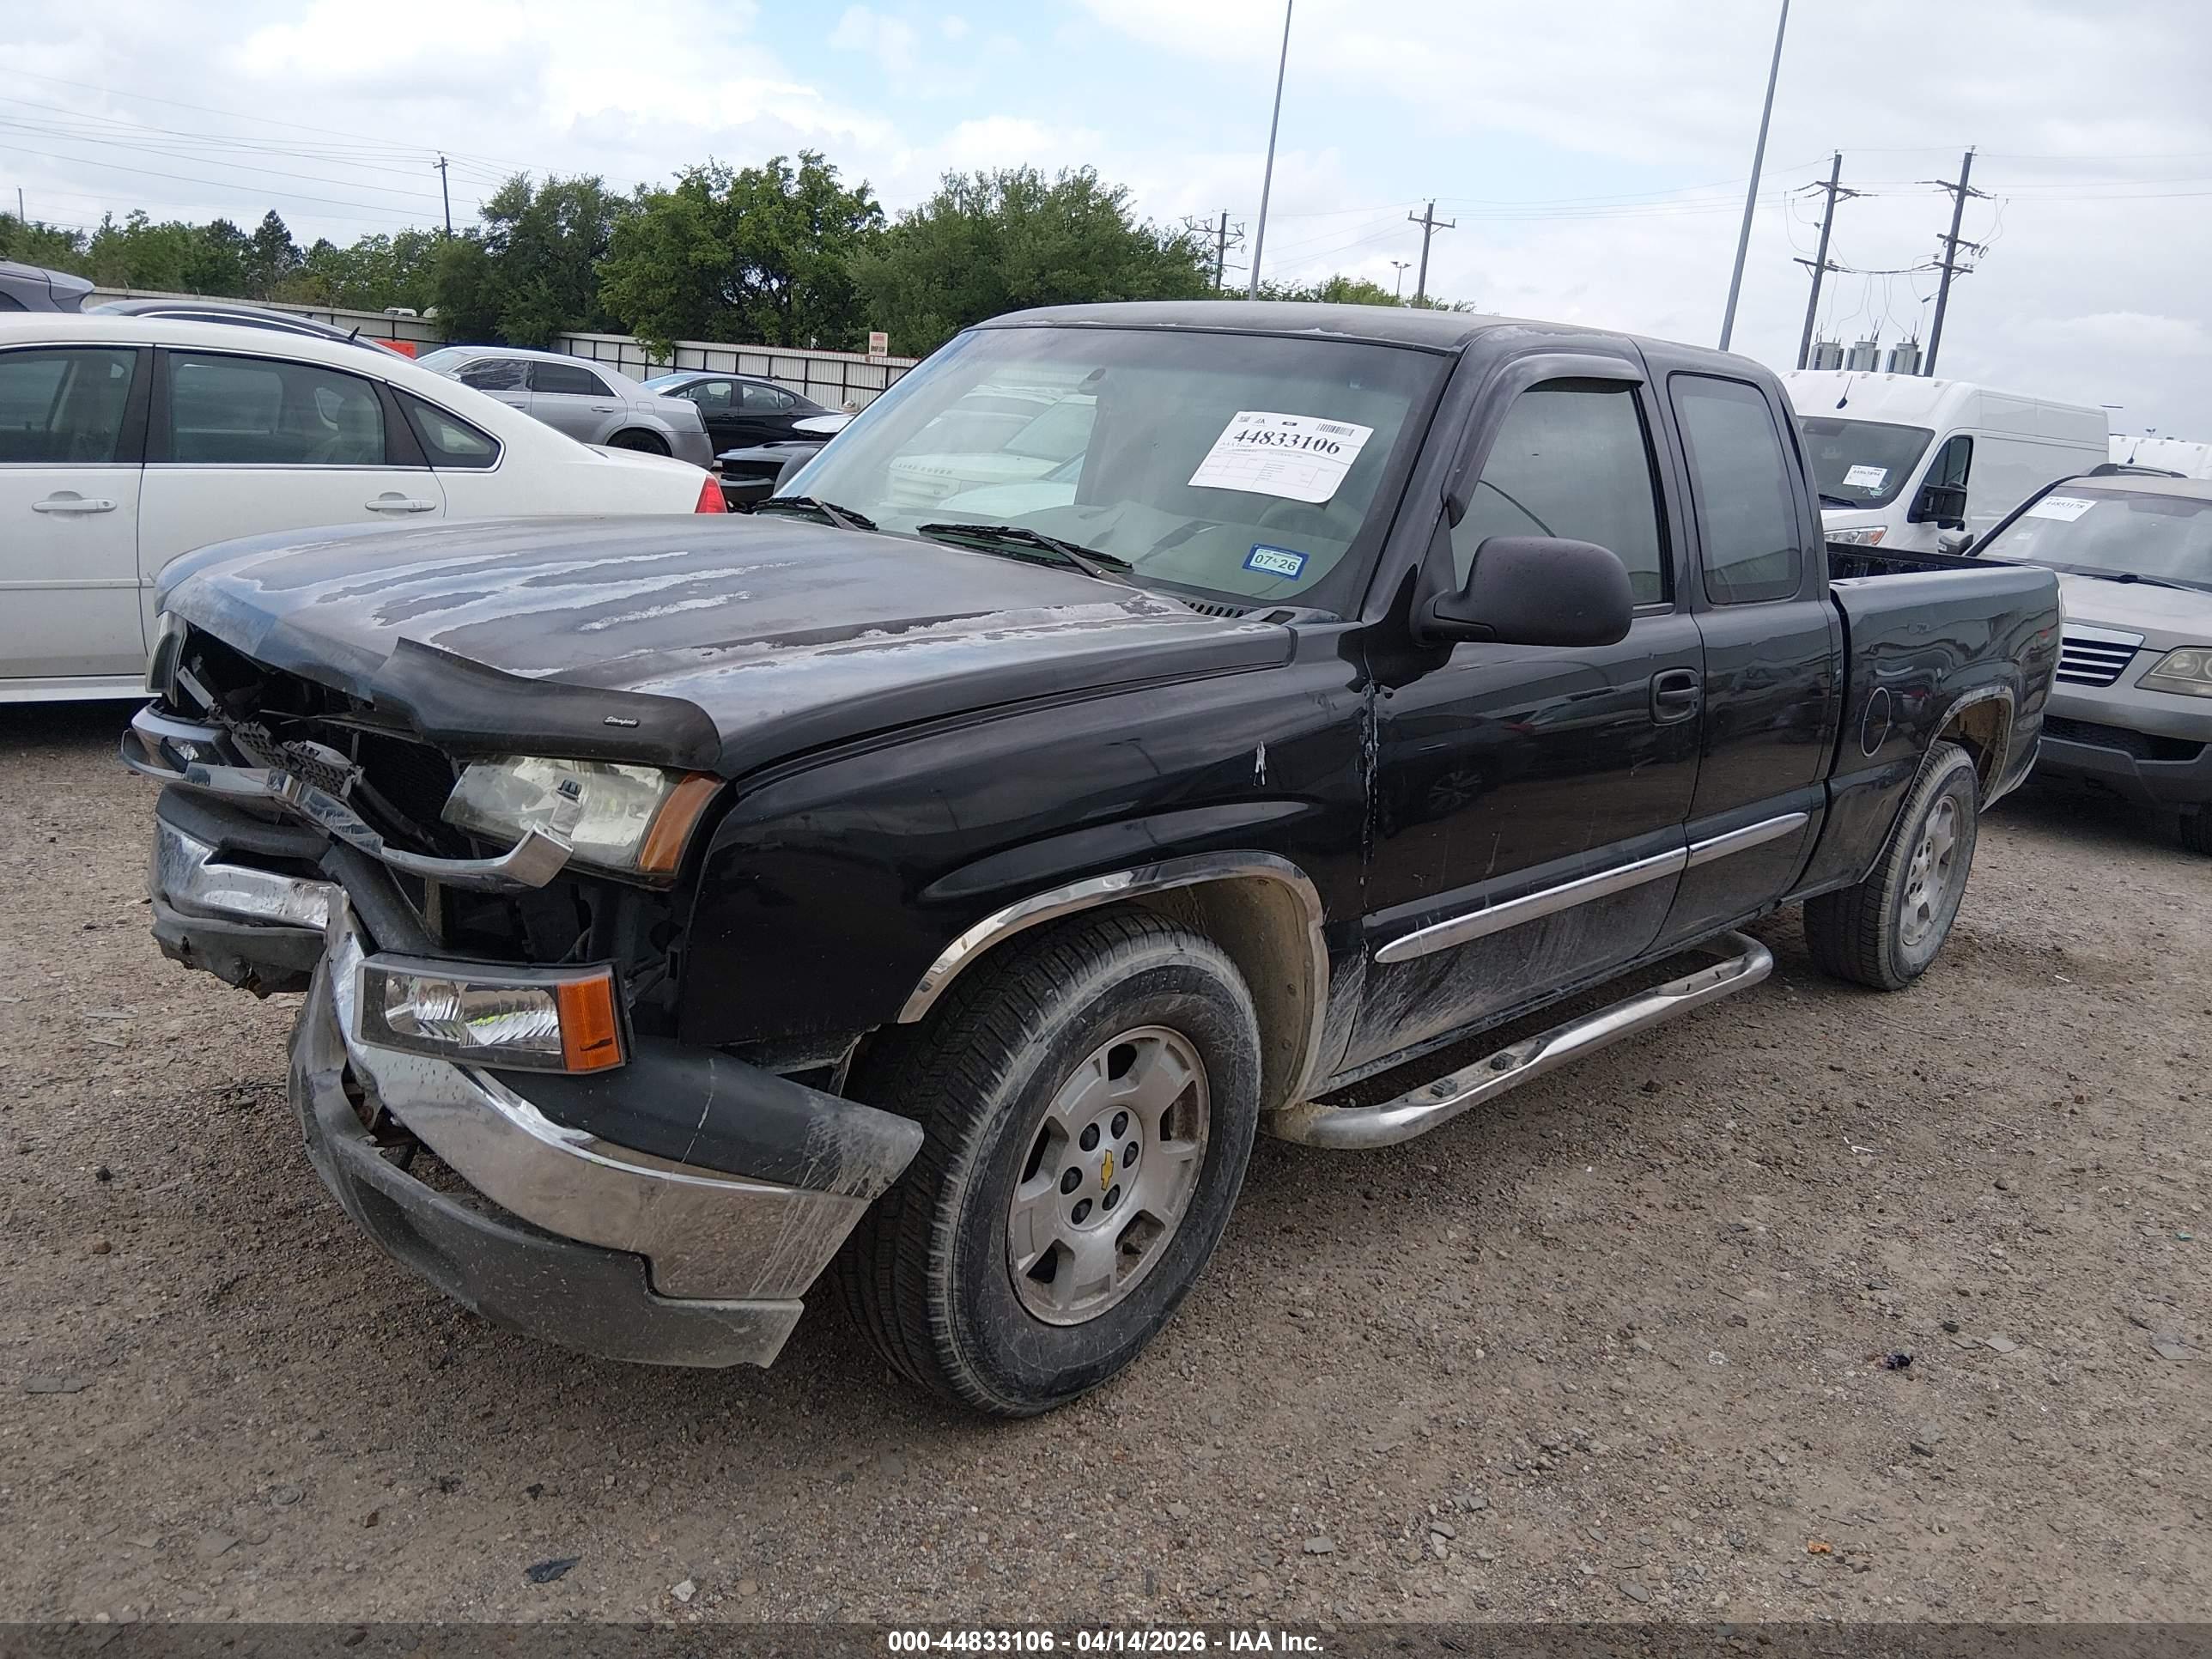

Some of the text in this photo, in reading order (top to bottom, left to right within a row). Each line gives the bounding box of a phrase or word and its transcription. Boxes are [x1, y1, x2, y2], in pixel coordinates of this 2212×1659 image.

[1233, 428, 1340, 455] 44833106
[1255, 554, 1273, 565] 07
[1278, 559, 1297, 571] 26
